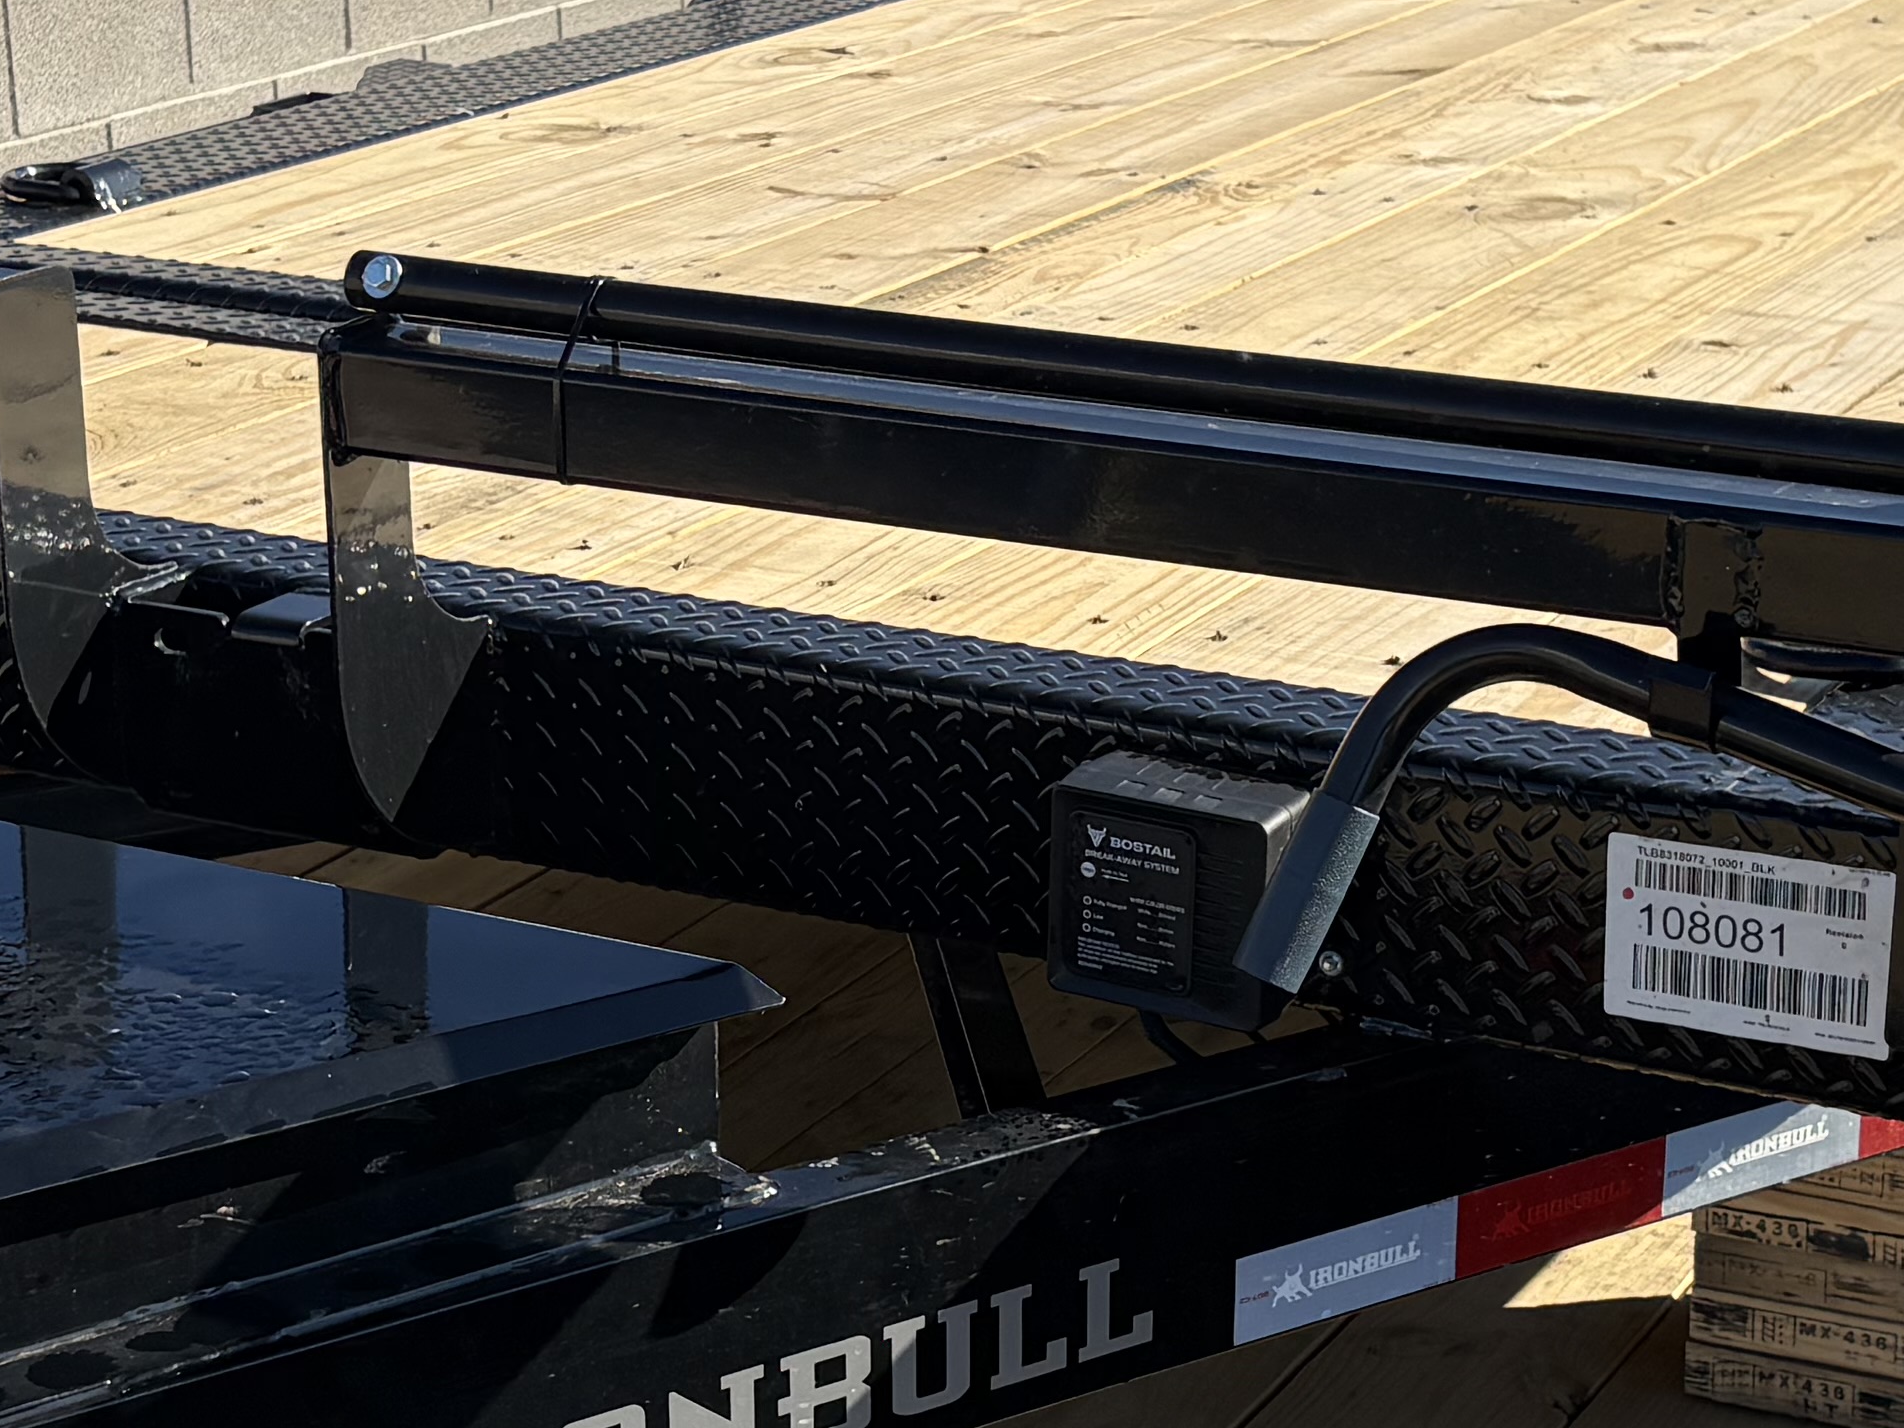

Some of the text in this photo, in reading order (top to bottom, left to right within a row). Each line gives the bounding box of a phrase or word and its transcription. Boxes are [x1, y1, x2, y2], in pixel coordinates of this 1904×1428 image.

[1109, 836, 1177, 860] BOSTAIL
[1143, 860, 1181, 875] SYSTEM
[1639, 902, 1787, 958] 108081
[1309, 1240, 1422, 1290] IRONBULL
